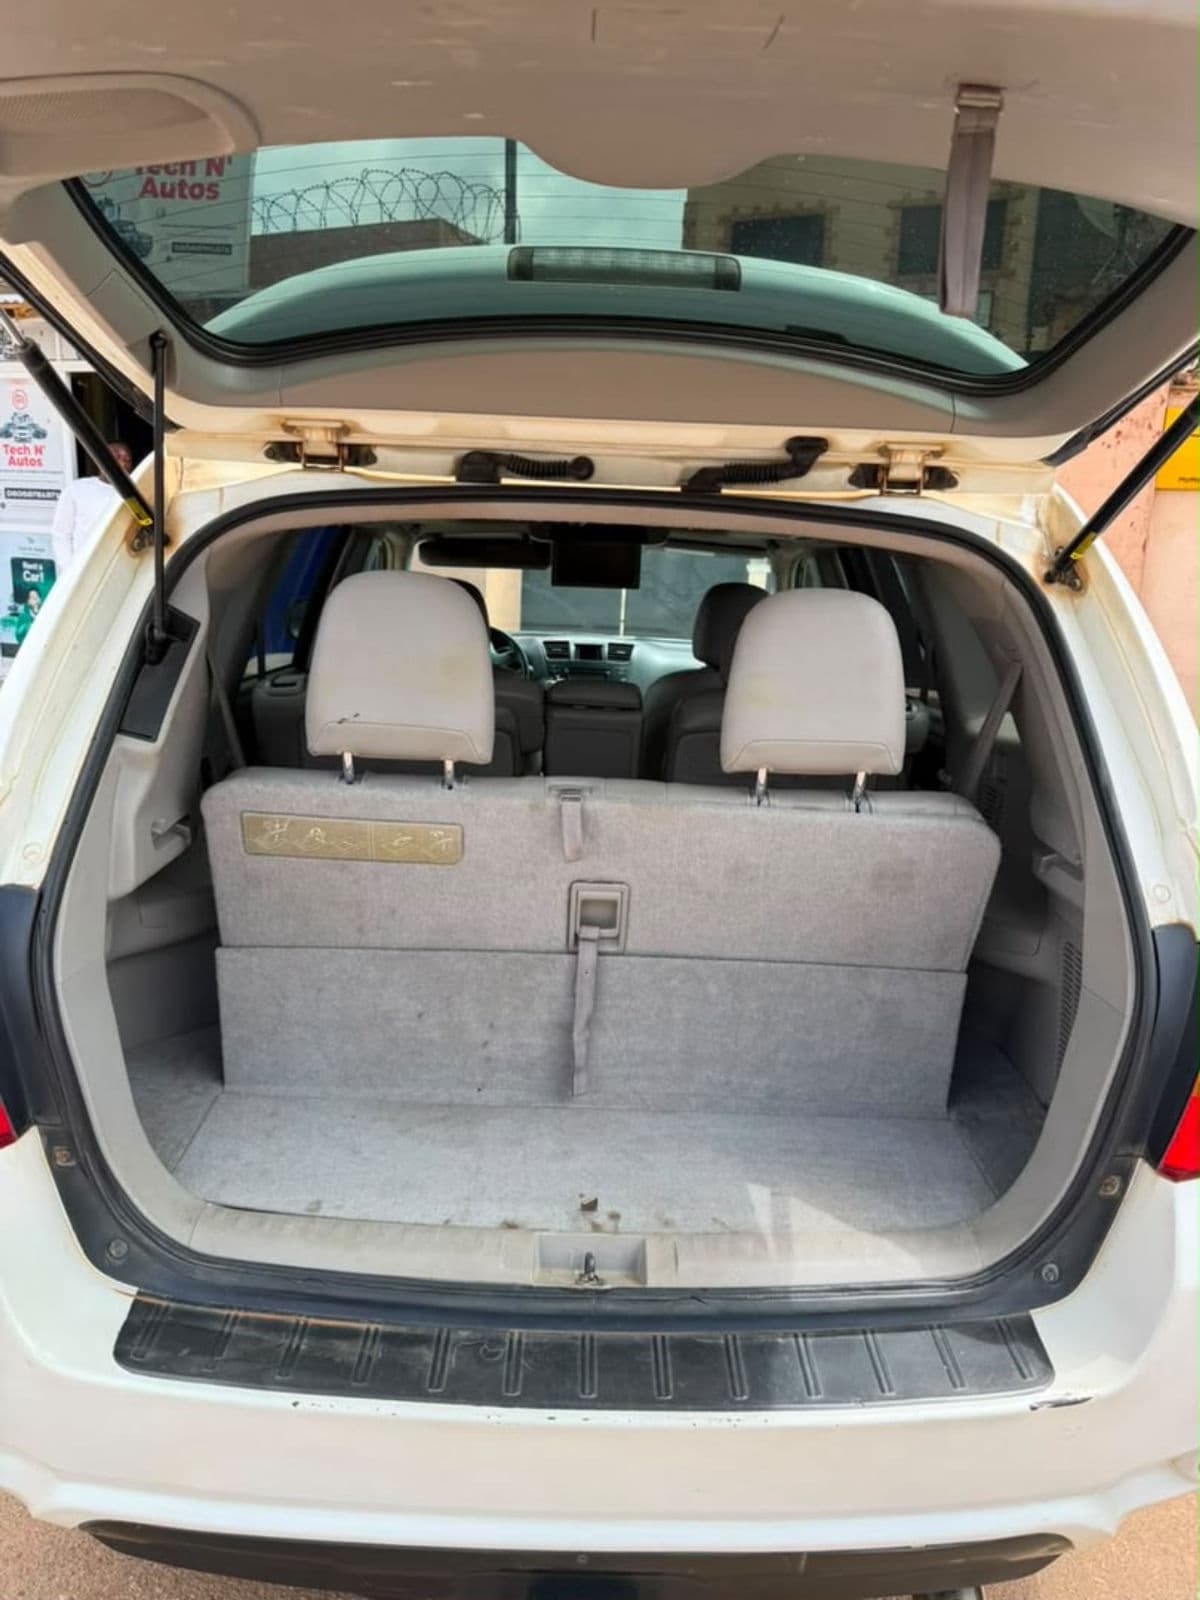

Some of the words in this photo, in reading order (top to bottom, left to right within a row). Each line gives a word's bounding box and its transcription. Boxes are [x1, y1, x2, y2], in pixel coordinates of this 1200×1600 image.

[139, 176, 221, 200] Autos
[2, 444, 31, 456] Tech
[8, 456, 43, 467] Autos
